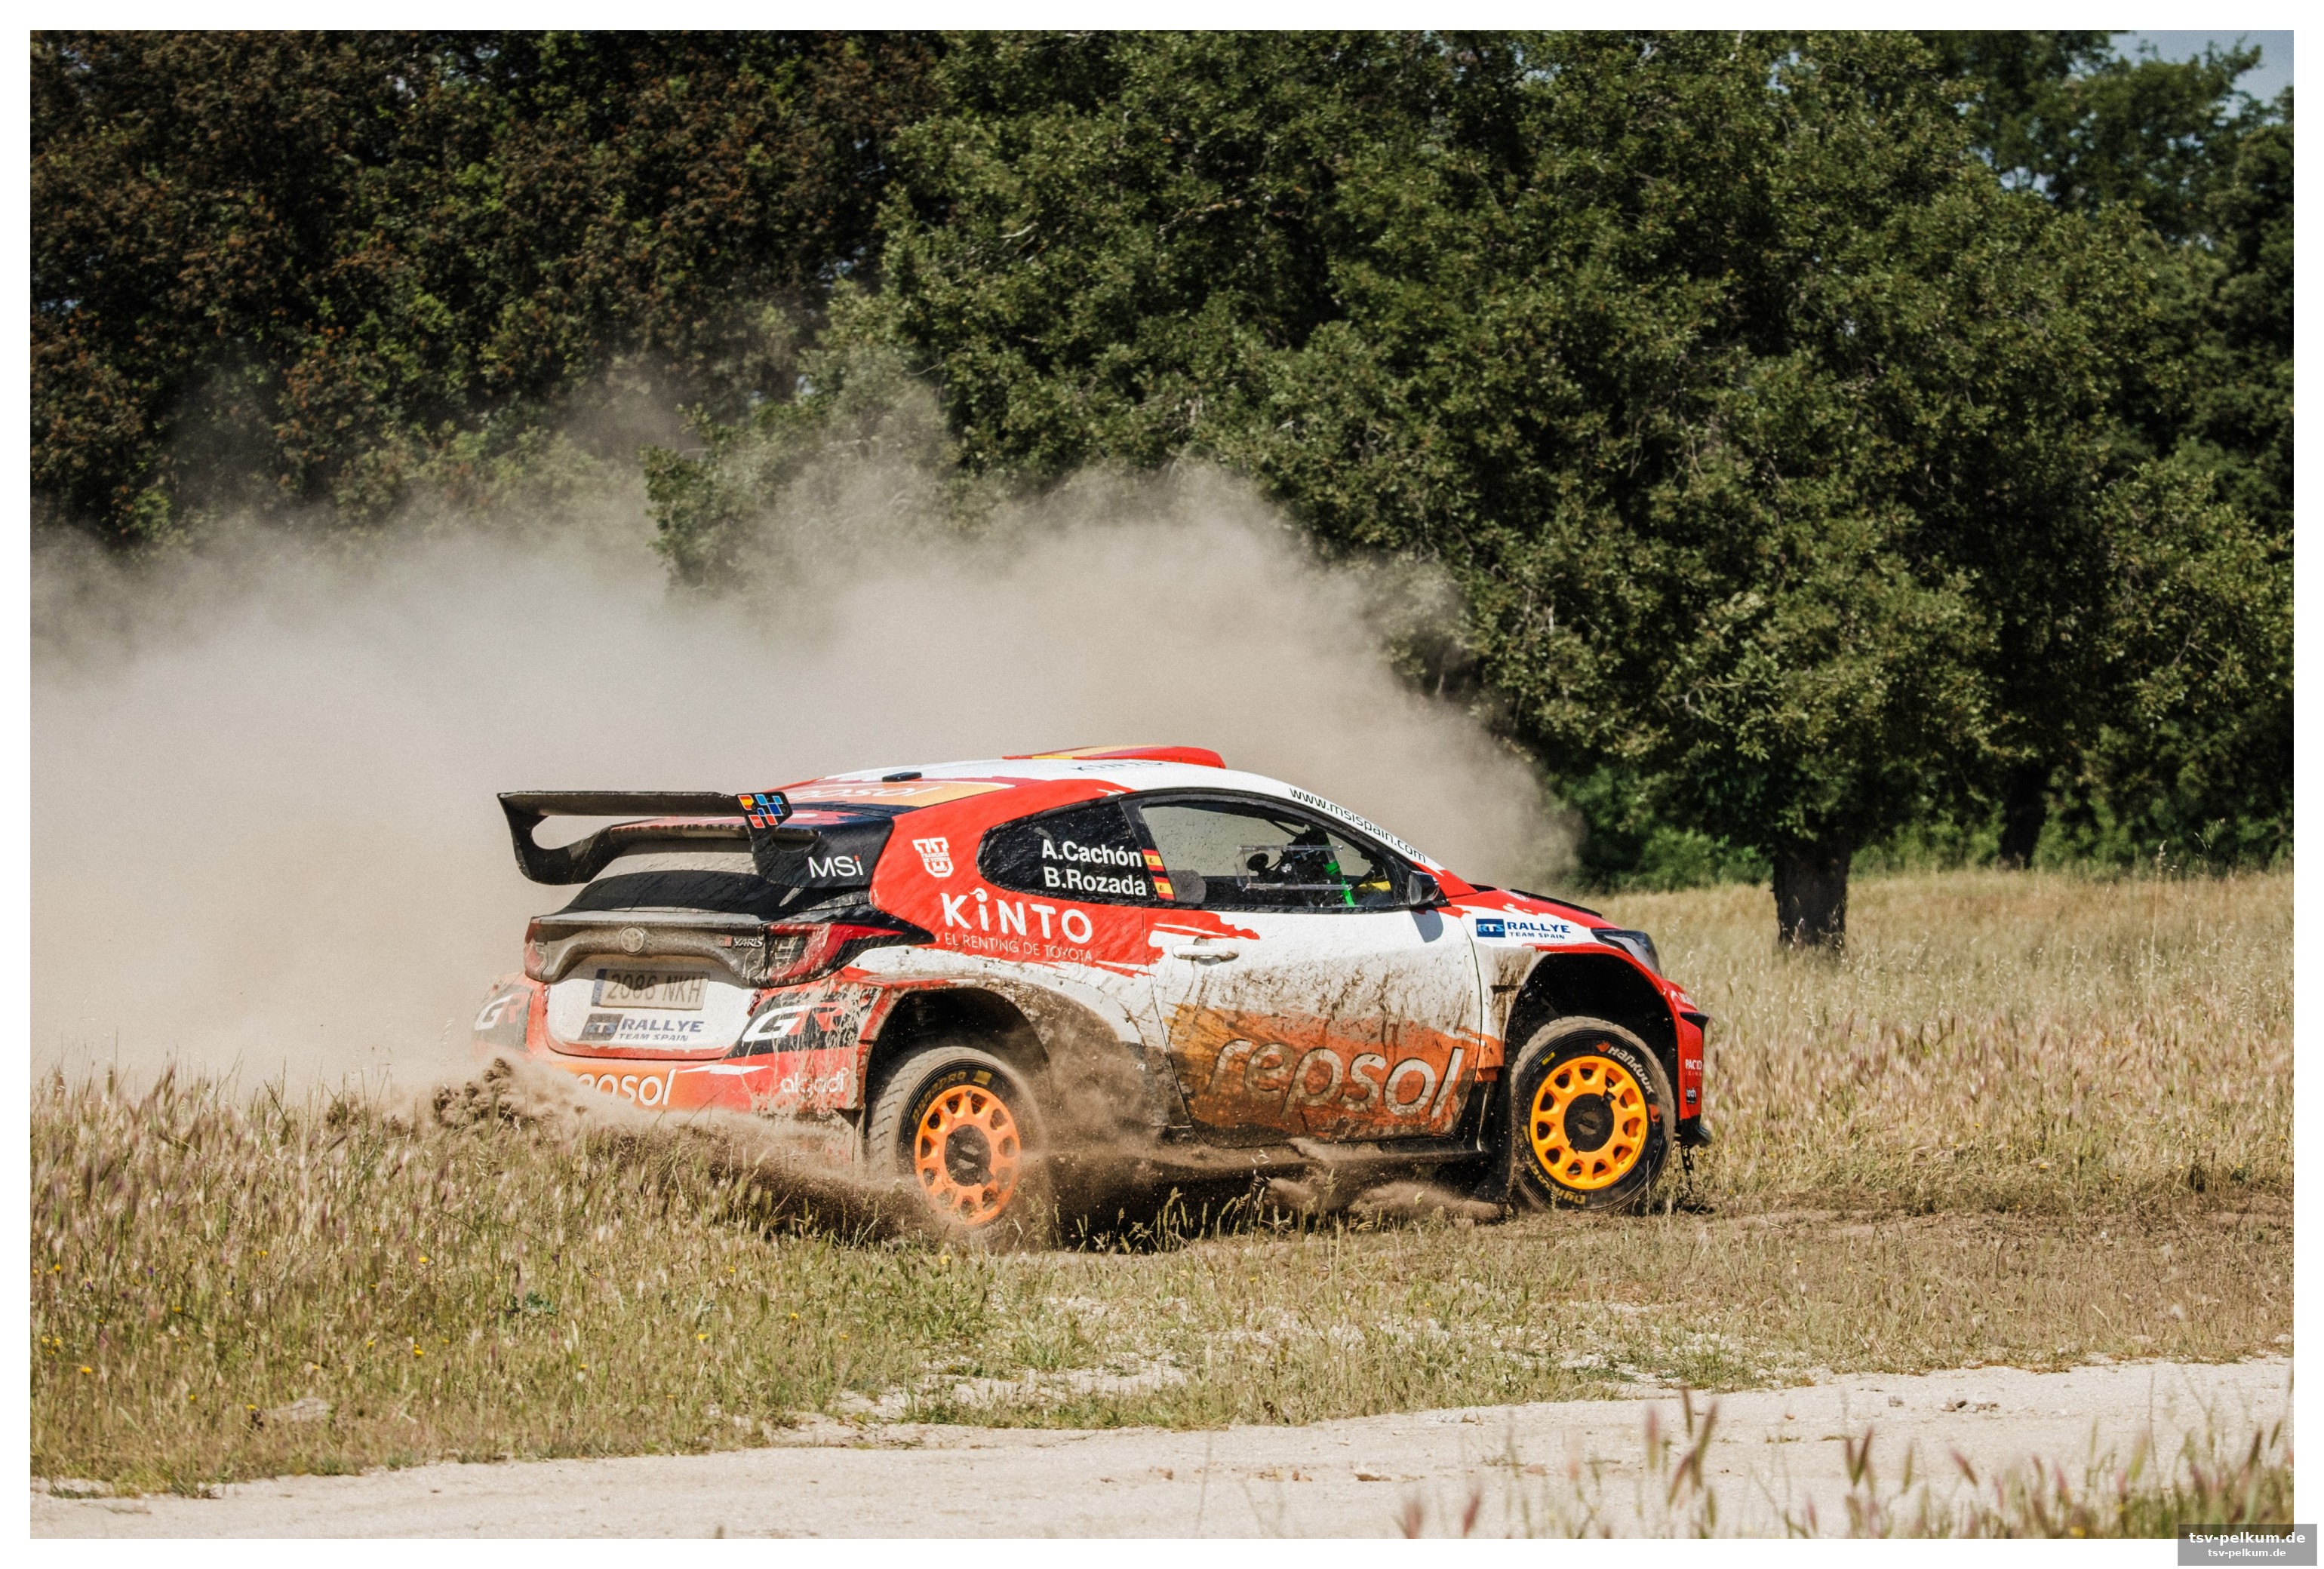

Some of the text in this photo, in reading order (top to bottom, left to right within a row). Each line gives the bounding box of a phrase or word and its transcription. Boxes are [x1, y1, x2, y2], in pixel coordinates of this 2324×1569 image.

[785, 786, 942, 802] epsol
[1289, 788, 1426, 864] www.msispain.com
[807, 855, 863, 879] MSi
[1041, 839, 1142, 867] A.Cachón
[1044, 867, 1147, 896] B.Rozada
[1477, 923, 1505, 932] RTS
[1507, 922, 1571, 934] RALLYE
[733, 938, 763, 947] YARIS
[944, 932, 1093, 962] EL RENTING DE TOYOTA
[607, 973, 702, 1003] 2086 NKH
[474, 992, 530, 1031] GR
[621, 1018, 705, 1033] RALLYE
[1208, 1039, 1465, 1120] repsol
